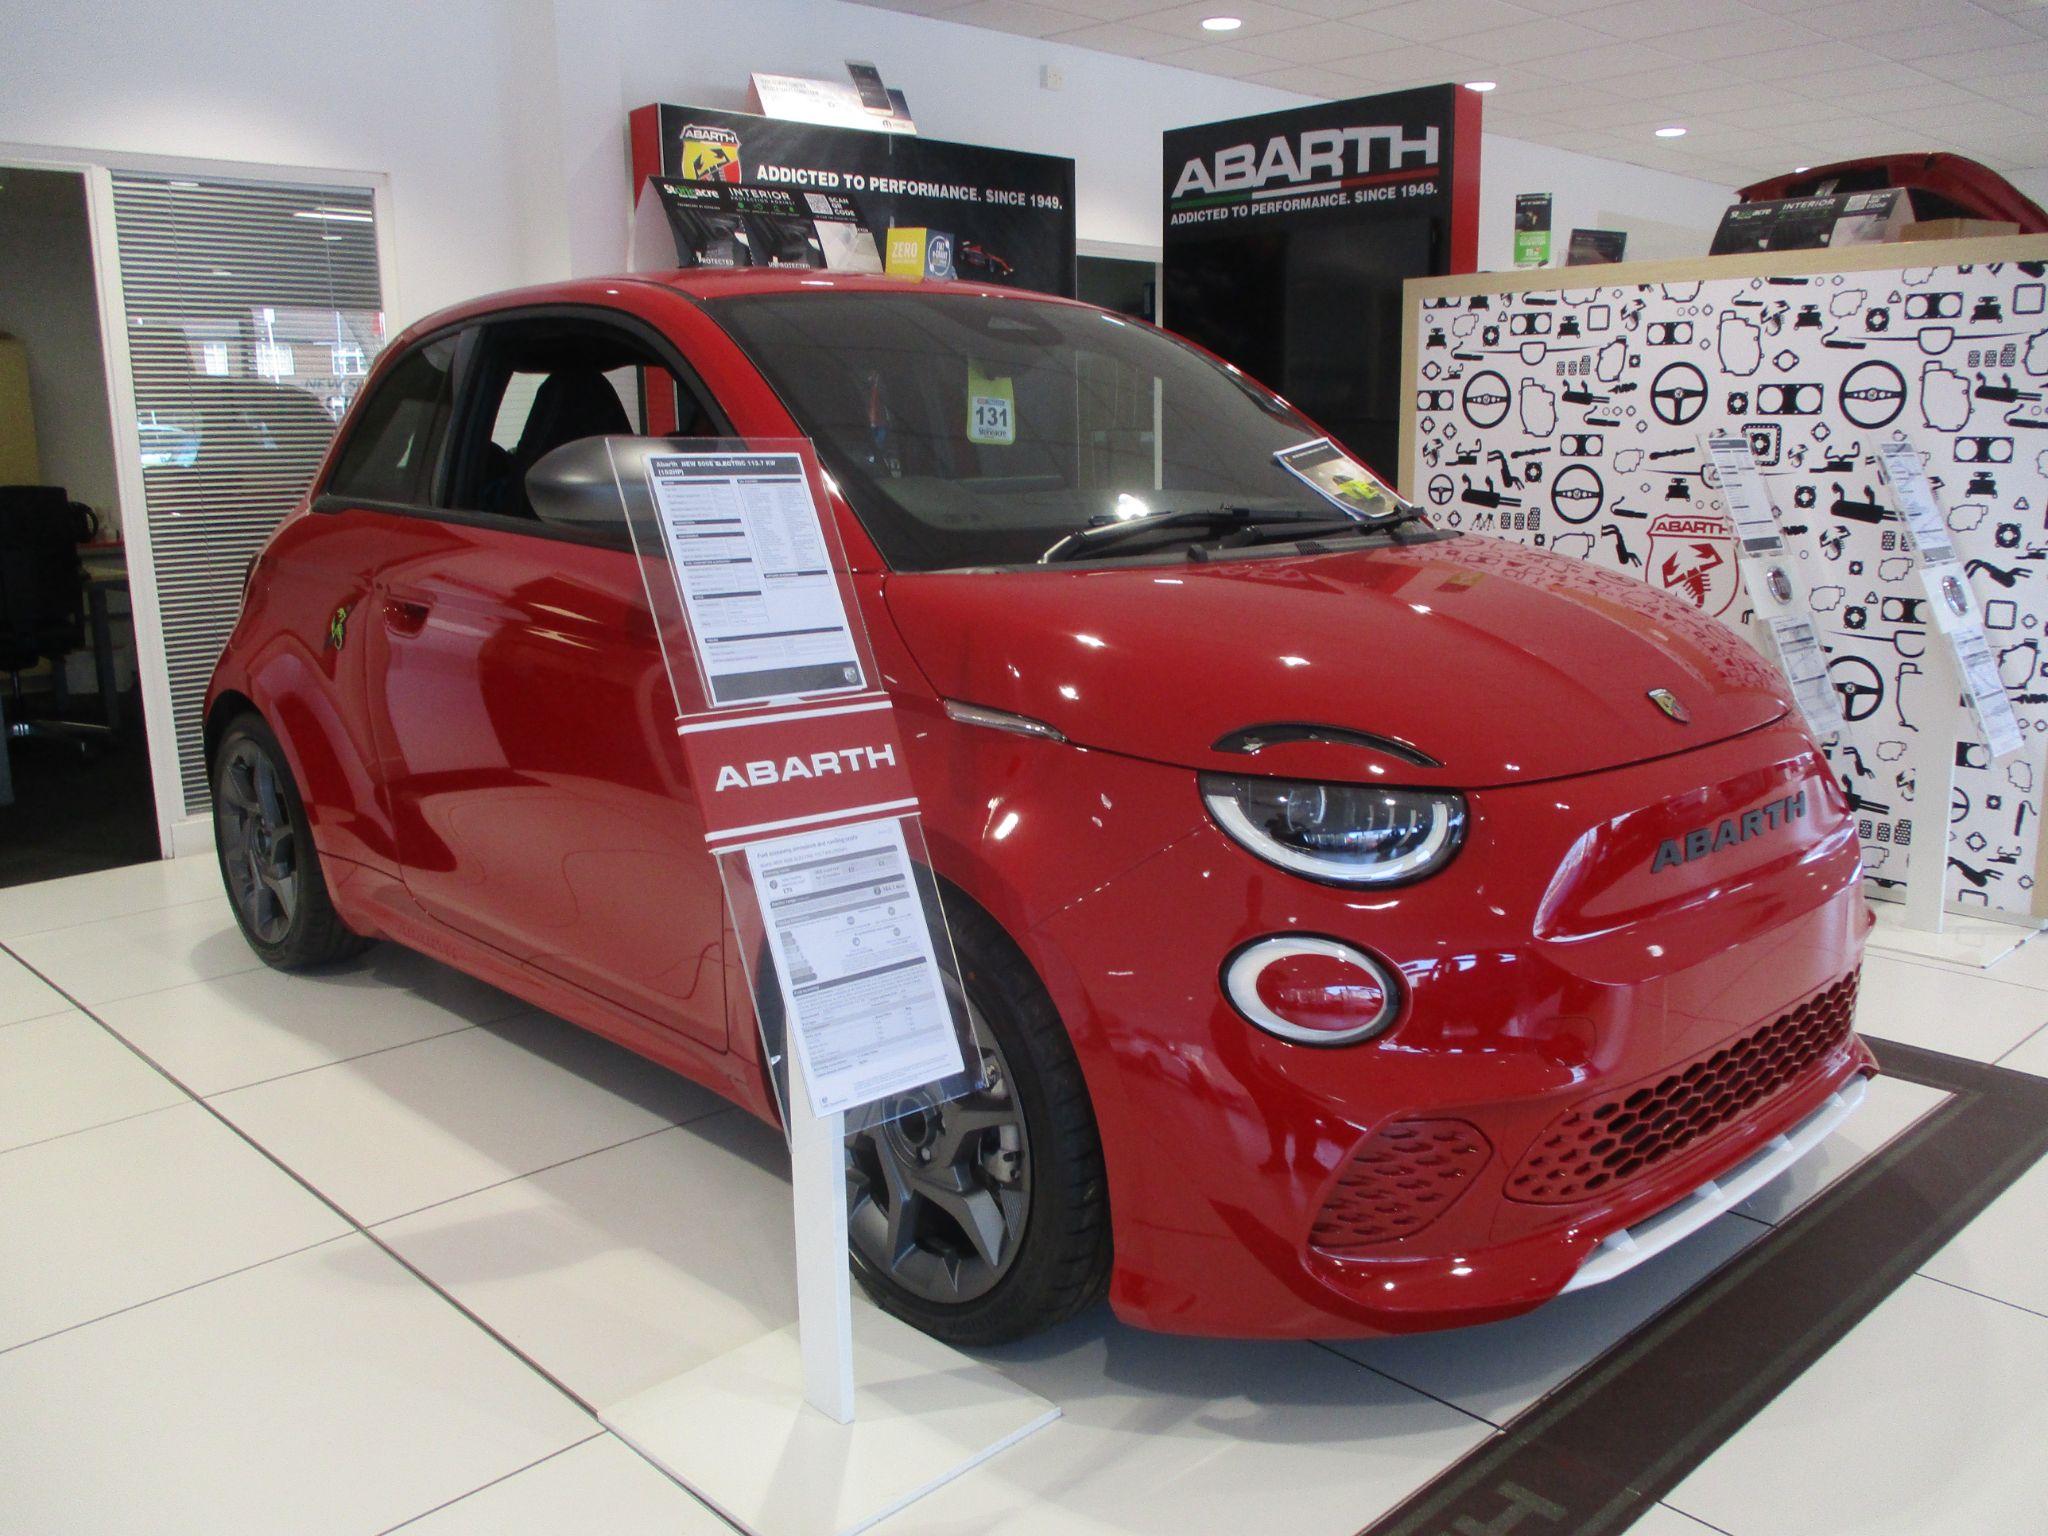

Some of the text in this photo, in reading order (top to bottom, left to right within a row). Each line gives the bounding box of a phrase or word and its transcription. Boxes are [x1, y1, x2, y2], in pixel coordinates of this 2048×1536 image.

[684, 129, 735, 143] ABARTH
[1171, 125, 1440, 199] ABARTH
[728, 187, 791, 201] INTERIOR
[756, 165, 1063, 210] ADDICTED TO PERFORMANCE. SINCE 1949.
[1171, 181, 1438, 226] ADDICTED TO PERFORMANCE. SINCE 1949.
[1782, 198, 1836, 211] INTERIOR
[891, 241, 918, 258] ZERO
[975, 406, 1008, 427] 131
[1655, 520, 1733, 534] ABARTH
[715, 743, 896, 792] ABARTH
[1650, 790, 1806, 874] ABARTH
